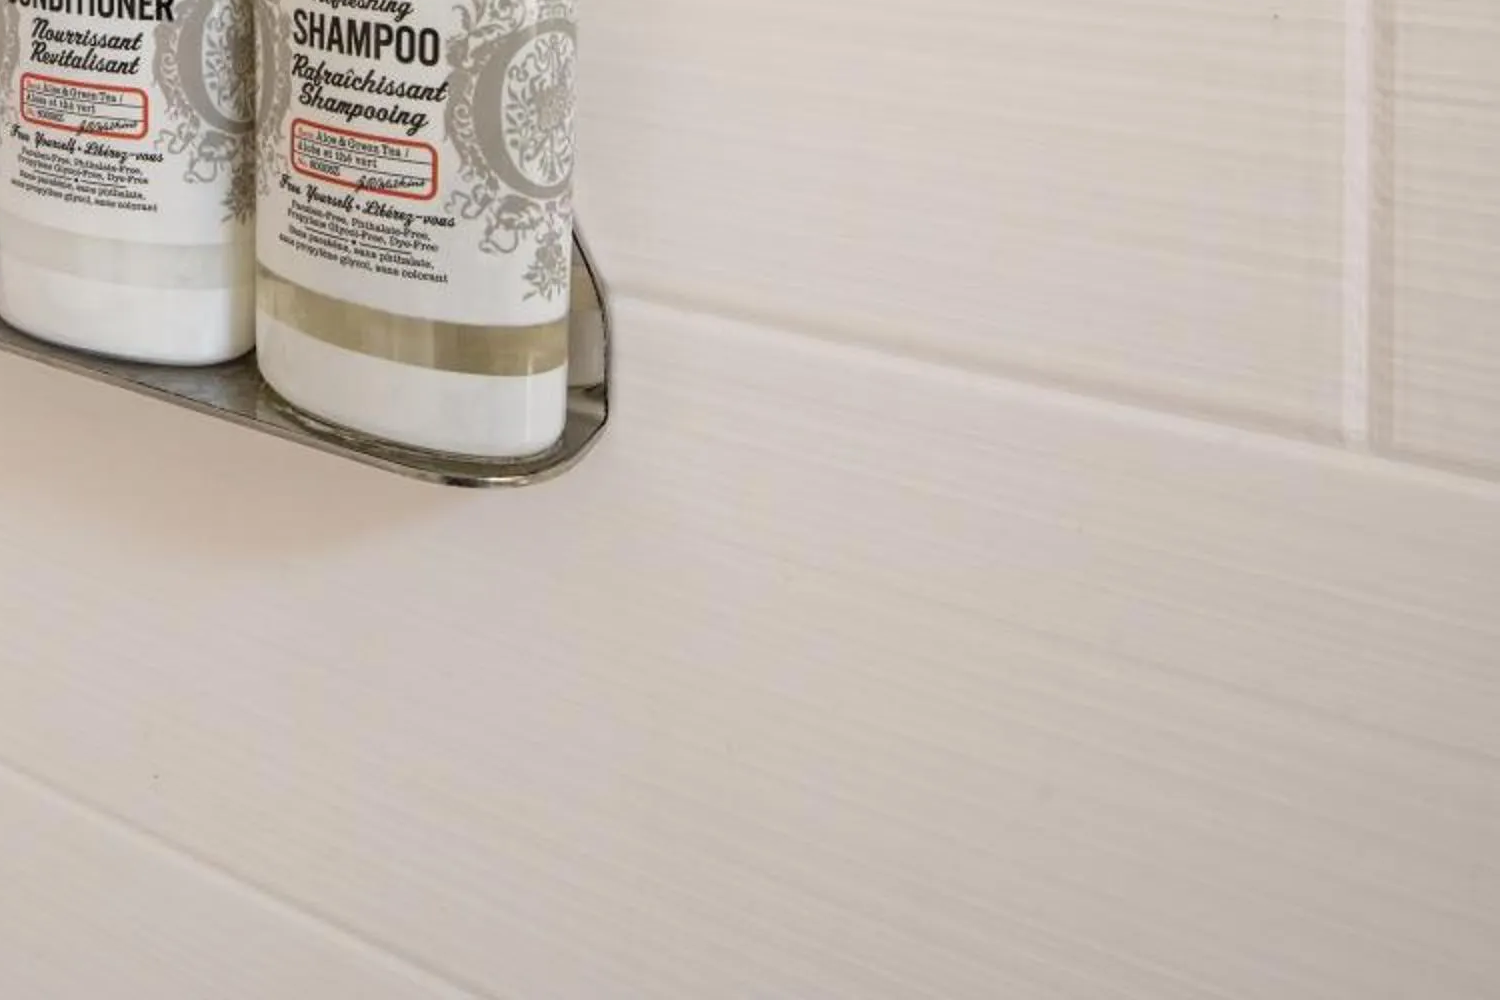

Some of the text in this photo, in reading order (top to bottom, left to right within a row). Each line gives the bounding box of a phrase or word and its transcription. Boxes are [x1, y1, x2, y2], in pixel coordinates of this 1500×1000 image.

[31, 17, 144, 50] Nourrissant
[293, 8, 440, 67] SHAMPOO
[30, 39, 140, 75] Revitalisant
[292, 53, 449, 102] Rafraîchissant
[299, 82, 429, 136] Shampooing
[306, 183, 355, 212] Yourself
